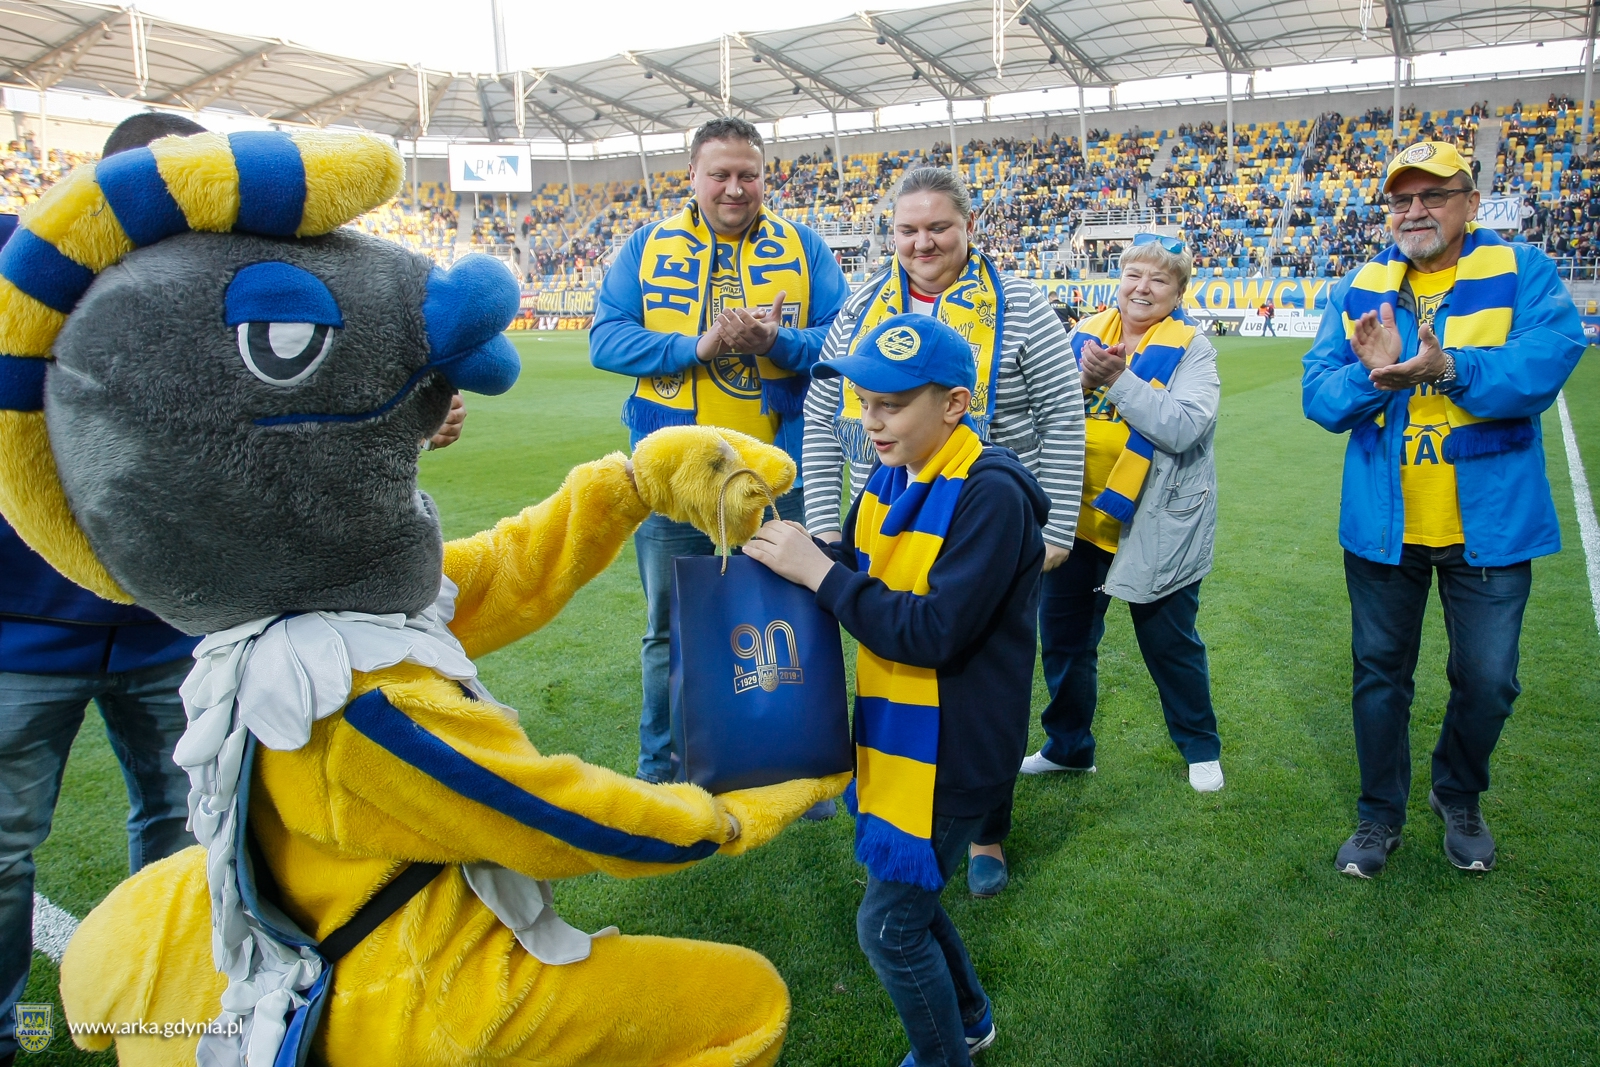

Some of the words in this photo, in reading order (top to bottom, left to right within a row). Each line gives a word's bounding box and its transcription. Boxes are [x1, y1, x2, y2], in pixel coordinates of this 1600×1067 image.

[475, 158, 507, 175] PKA
[642, 227, 708, 316] HEJ
[740, 675, 758, 688] 1929
[780, 671, 797, 680] 2019
